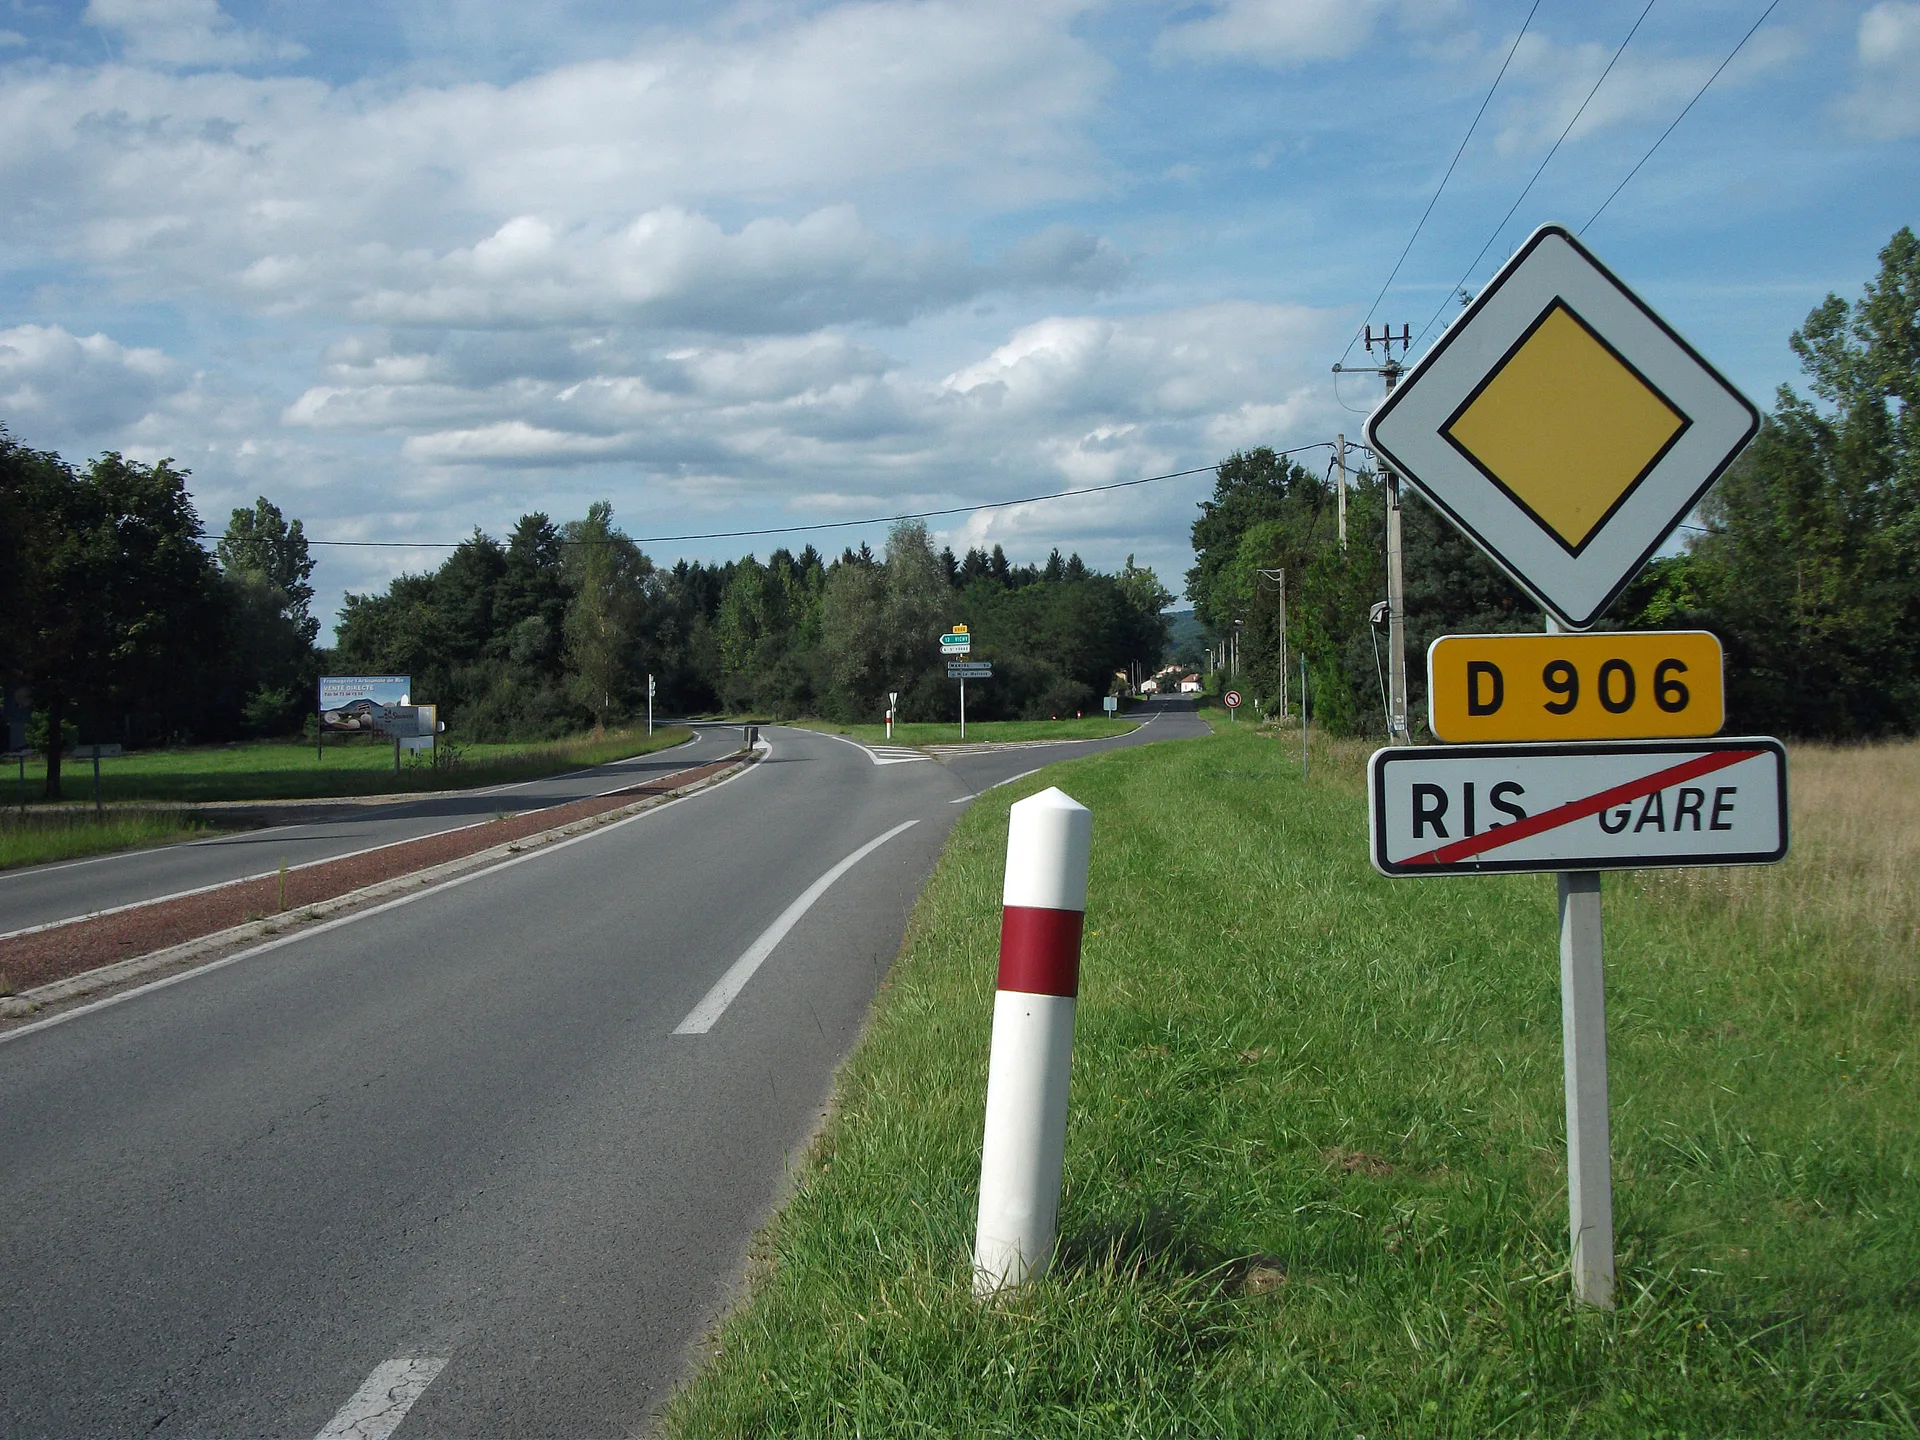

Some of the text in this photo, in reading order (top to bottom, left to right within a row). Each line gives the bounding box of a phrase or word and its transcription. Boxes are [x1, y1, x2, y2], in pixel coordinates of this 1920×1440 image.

[1467, 659, 1689, 716] D 906
[1412, 781, 1738, 839] RIS GARE
